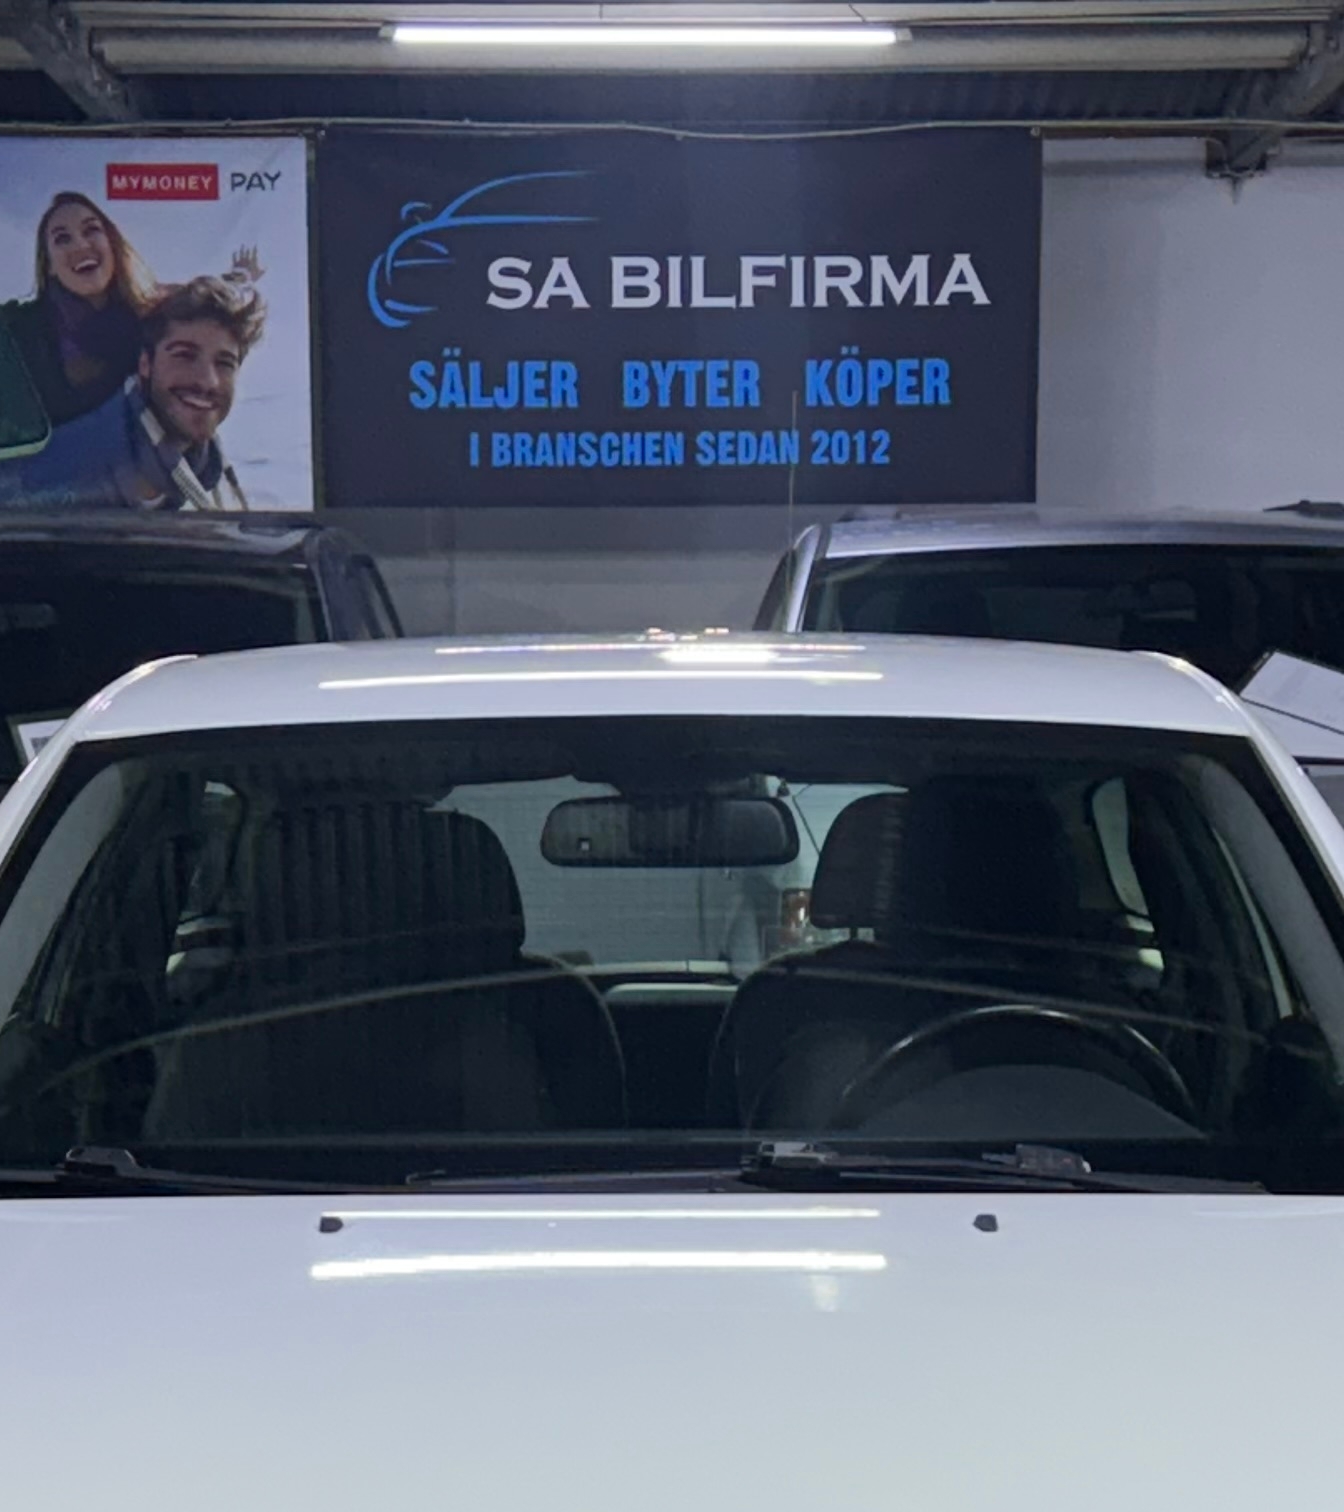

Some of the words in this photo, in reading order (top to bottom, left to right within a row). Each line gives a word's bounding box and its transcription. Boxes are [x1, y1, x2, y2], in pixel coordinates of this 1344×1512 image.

[112, 175, 212, 190] MYMONEY
[231, 171, 281, 192] PAY
[486, 255, 591, 309] SA
[609, 253, 991, 309] BILFIRMA
[409, 347, 578, 409] SÄLJER
[622, 359, 760, 408] BYTER
[805, 346, 952, 405] KÖPER
[469, 432, 479, 467] I
[491, 431, 684, 467] BRANSCHEN
[695, 430, 799, 465] SEDAN
[810, 429, 890, 465] 2012
